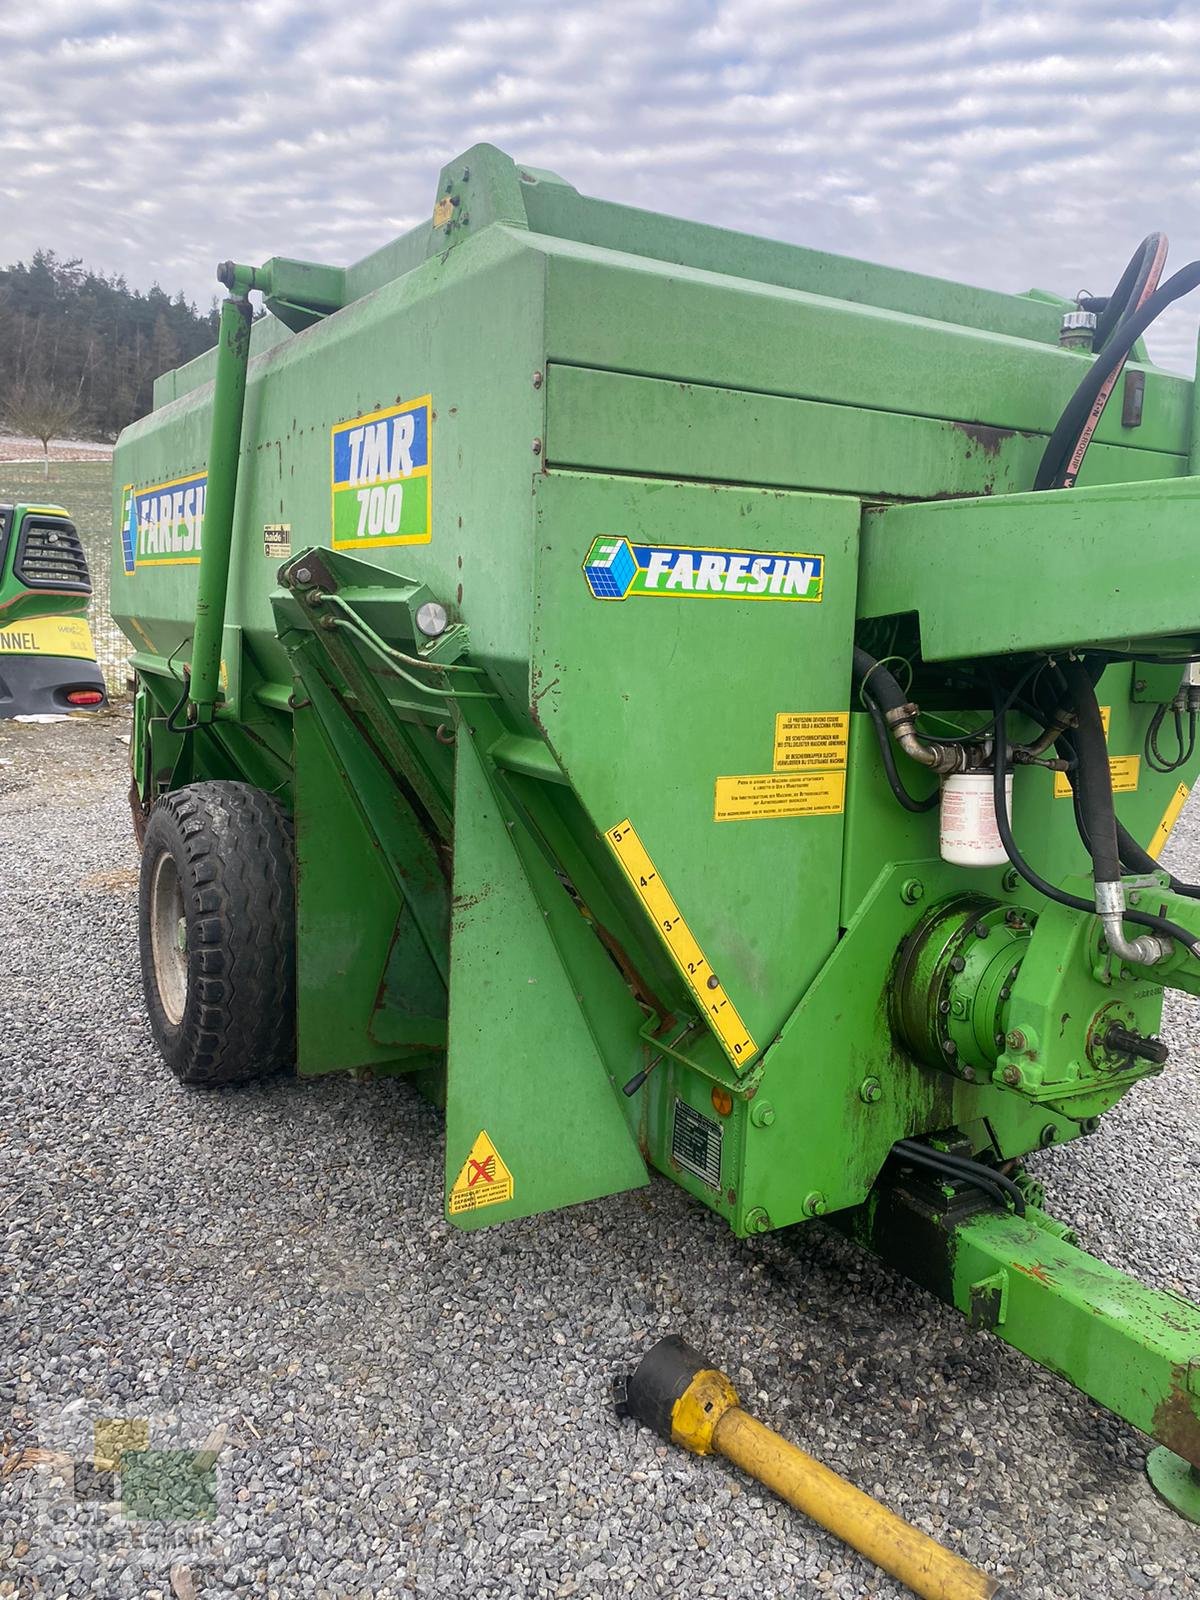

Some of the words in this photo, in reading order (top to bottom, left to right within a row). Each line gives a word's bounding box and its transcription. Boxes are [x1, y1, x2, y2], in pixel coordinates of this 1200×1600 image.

[349, 415, 415, 487] TMR
[1072, 427, 1092, 469] AEROQUIP
[357, 484, 403, 536] 700
[644, 552, 814, 595] FARESIN
[613, 830, 622, 842] 5
[639, 876, 648, 887] 4
[663, 920, 672, 932] 3
[687, 963, 697, 974] 2
[711, 1004, 719, 1014] 1
[734, 1043, 742, 1054] 0
